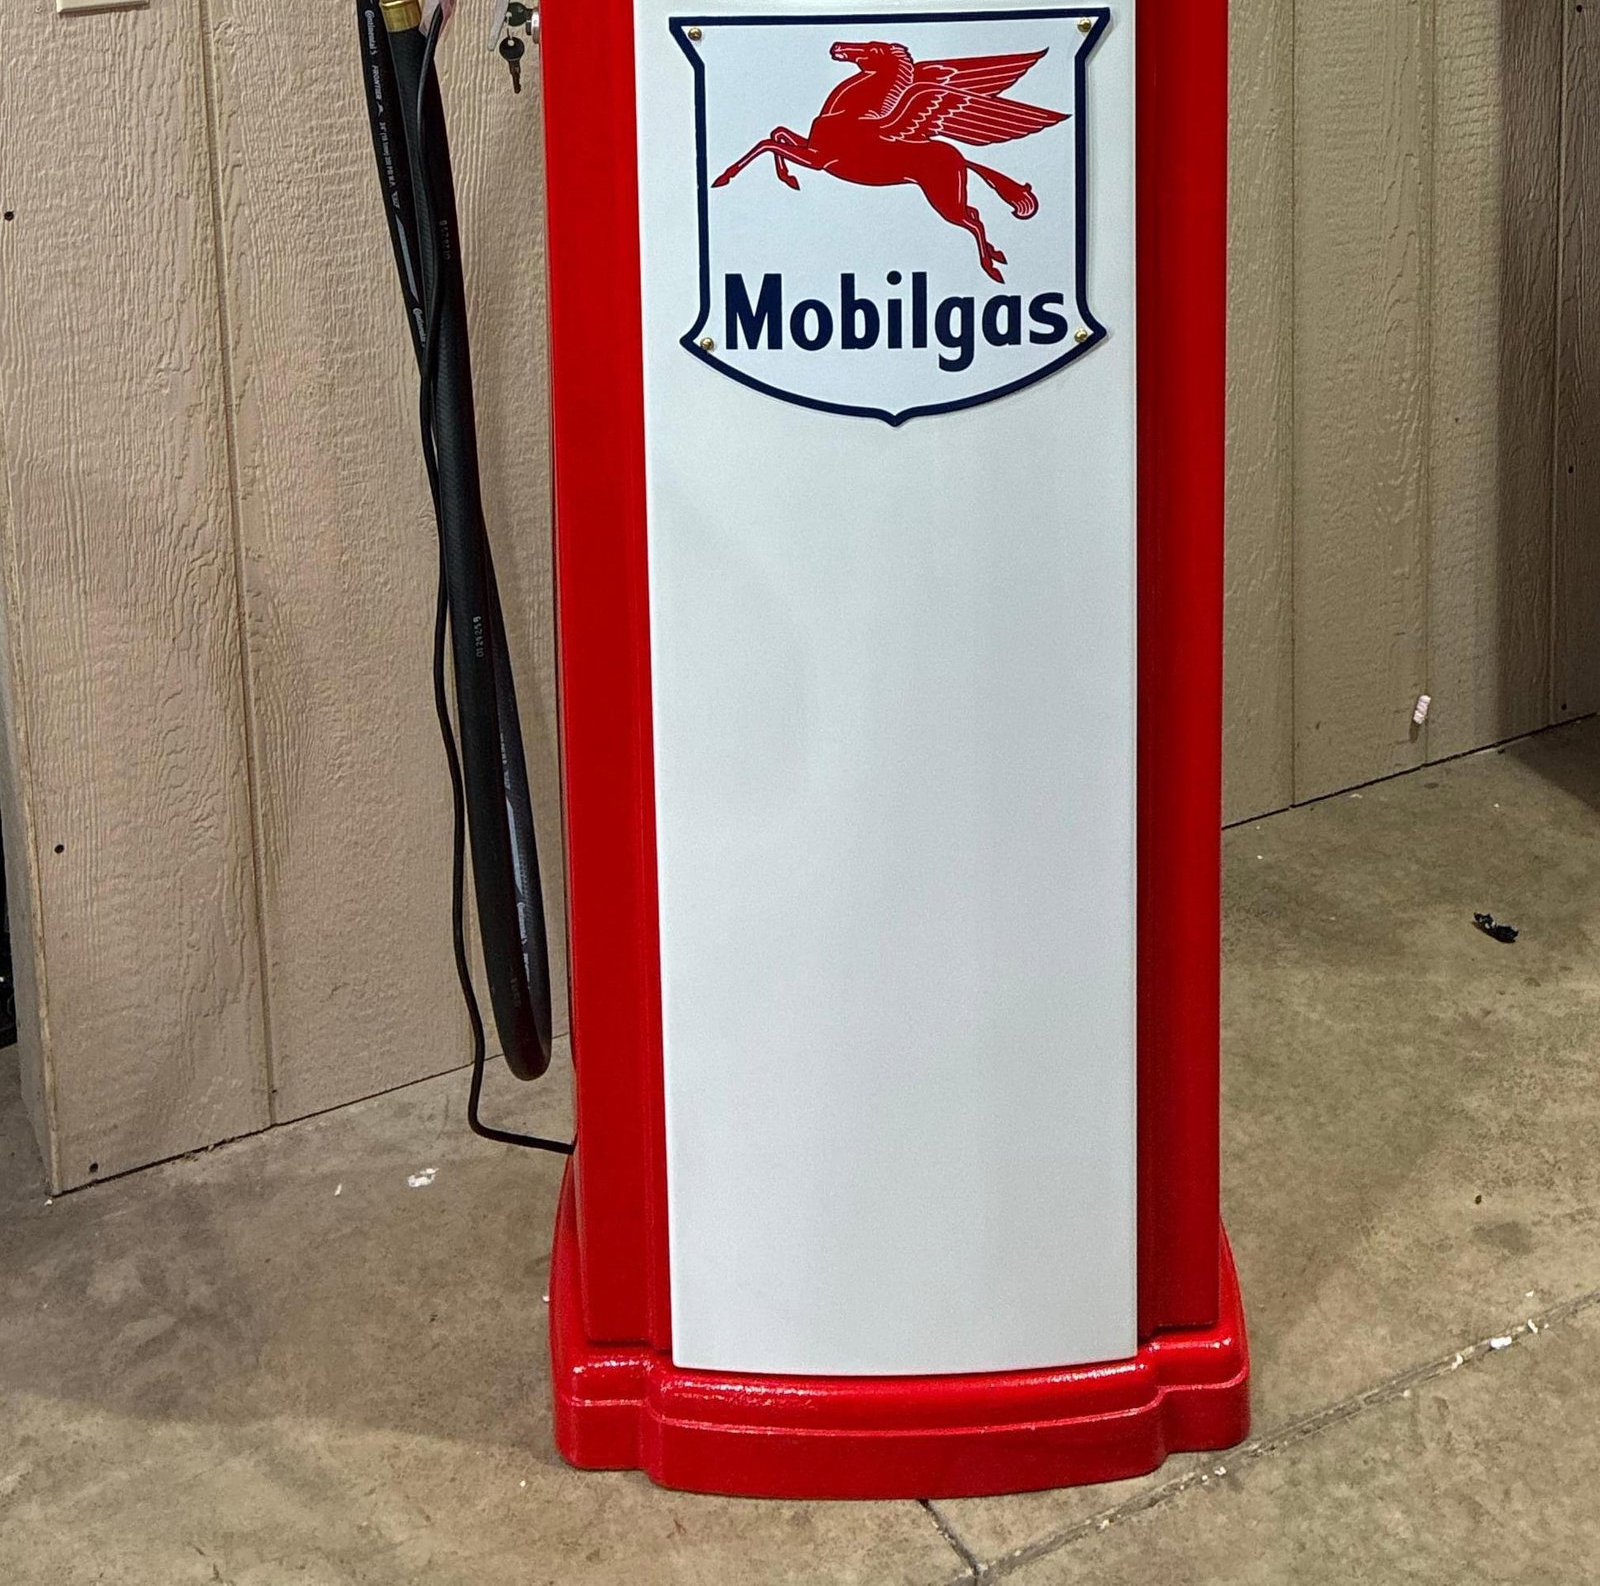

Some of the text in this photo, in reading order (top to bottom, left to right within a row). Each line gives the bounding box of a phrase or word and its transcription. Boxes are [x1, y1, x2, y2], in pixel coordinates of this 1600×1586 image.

[364, 10, 377, 50] Continental
[371, 64, 382, 100] FRONTIER
[725, 270, 1069, 372] Mobilgas
